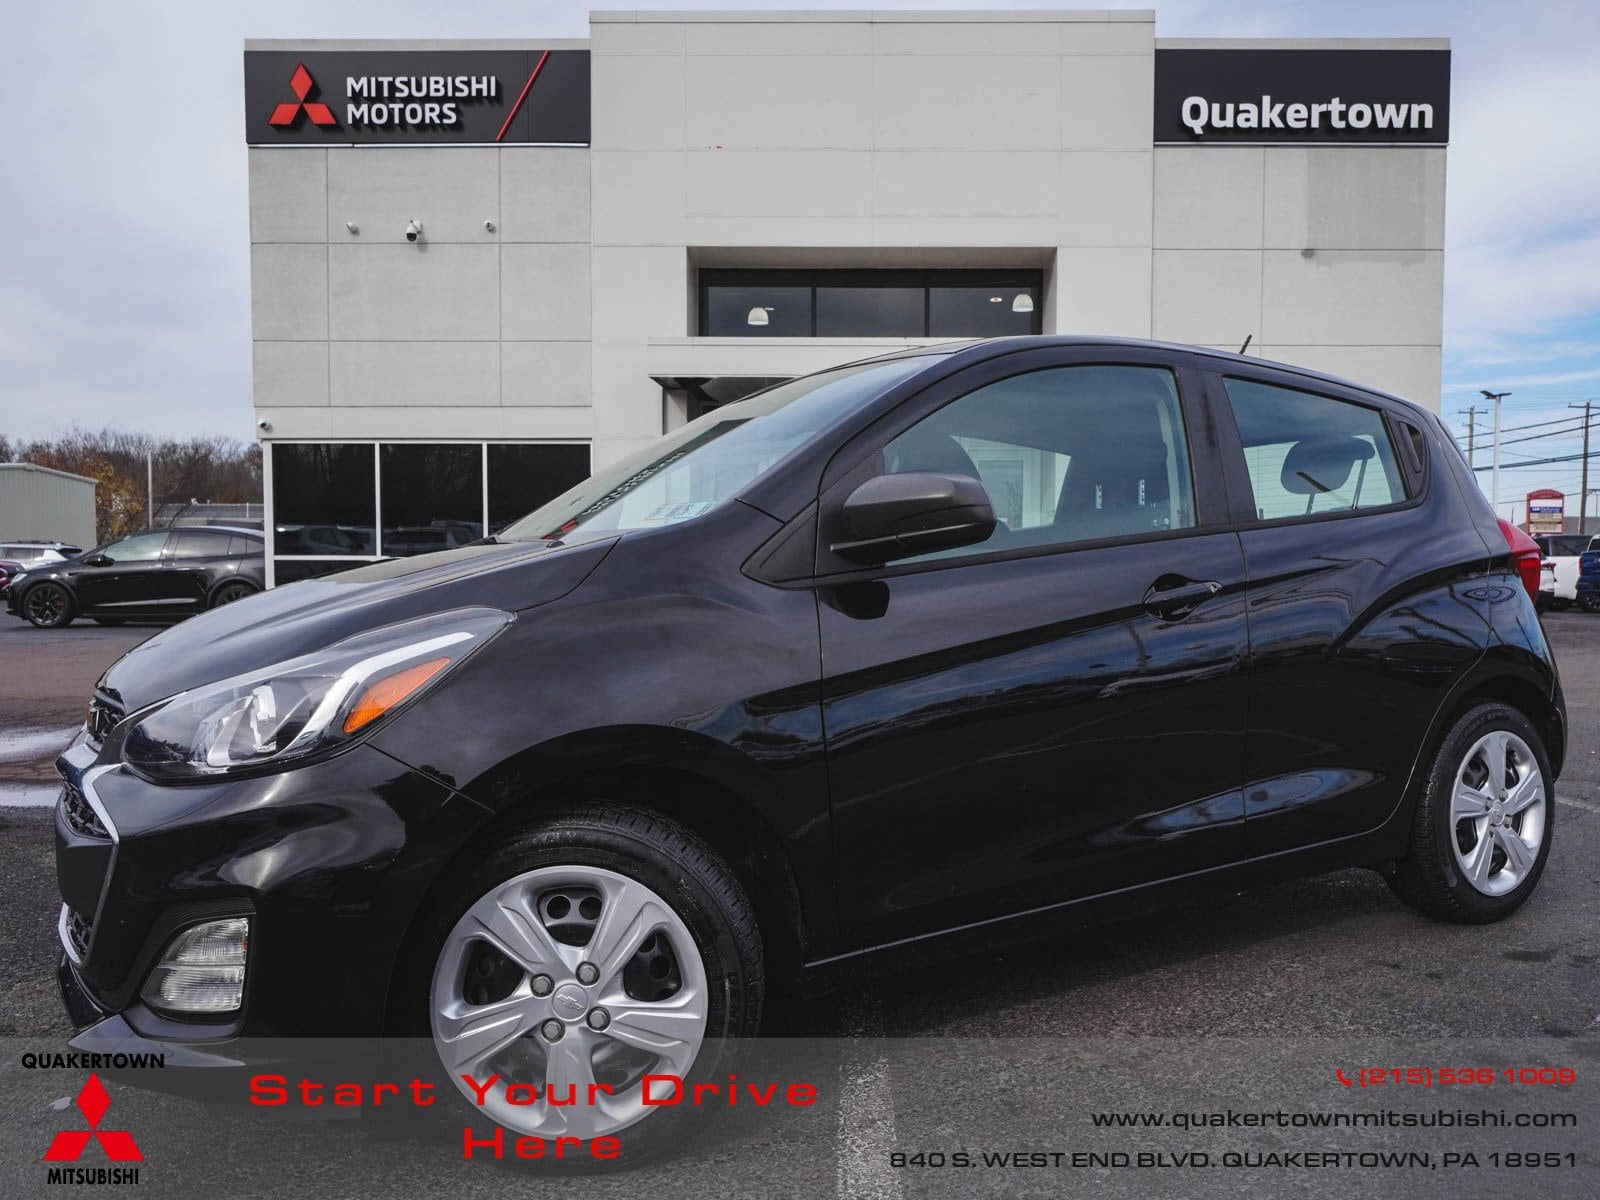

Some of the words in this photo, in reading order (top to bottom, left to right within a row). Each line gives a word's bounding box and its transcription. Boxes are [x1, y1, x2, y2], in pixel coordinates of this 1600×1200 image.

[346, 76, 496, 97] MITSUBISHI
[347, 103, 457, 125] MOTORS
[1181, 95, 1434, 135] Quakertown
